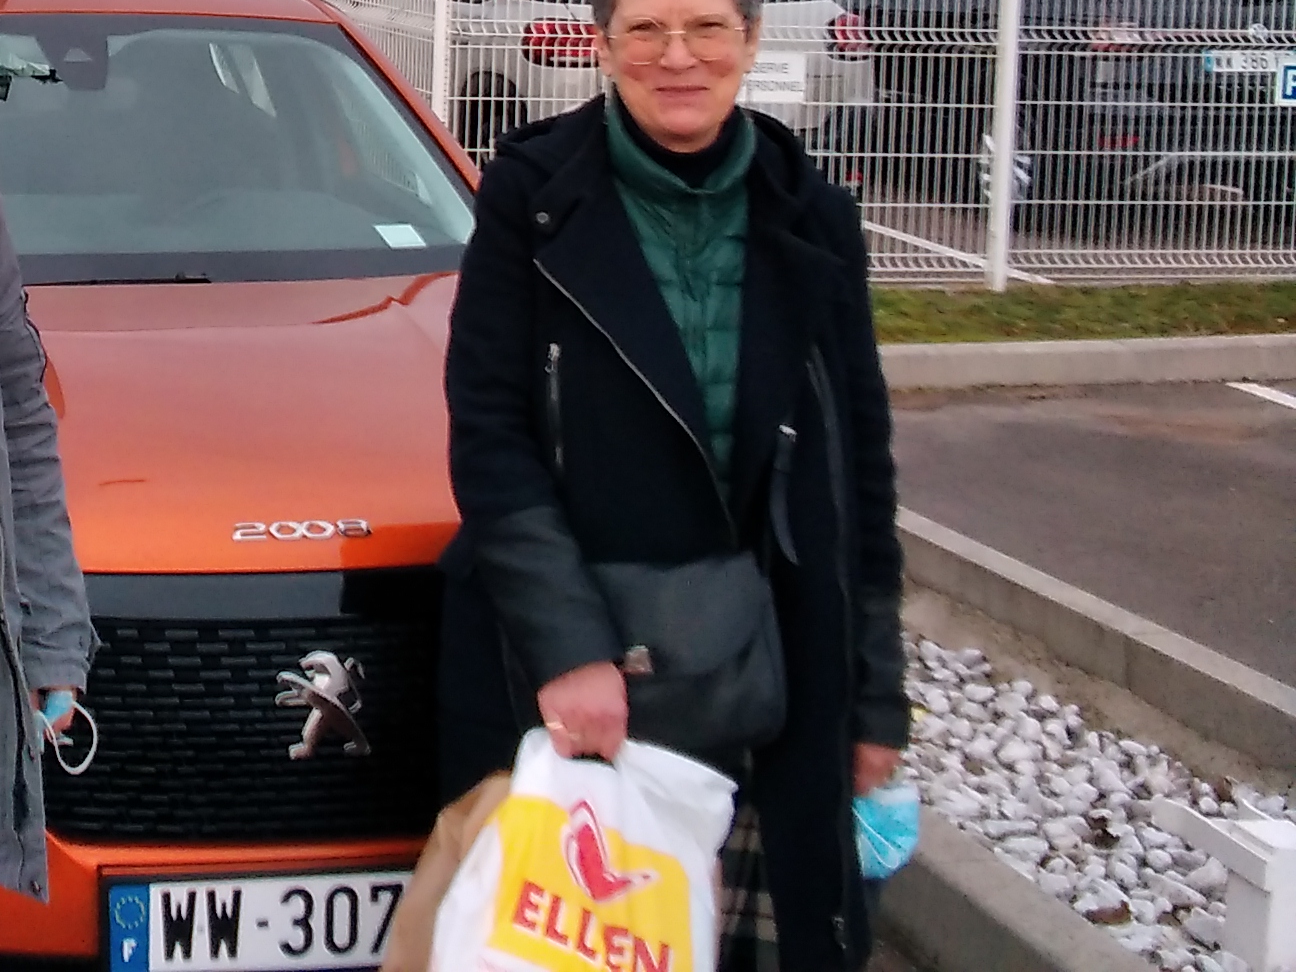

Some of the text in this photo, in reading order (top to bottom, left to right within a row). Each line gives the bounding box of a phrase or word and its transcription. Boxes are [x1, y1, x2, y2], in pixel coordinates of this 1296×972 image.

[753, 61, 789, 74] SERVE
[747, 79, 804, 92] ERSONNEL
[232, 518, 372, 542] 2008
[512, 880, 672, 972] ELLEN
[122, 937, 138, 963] F
